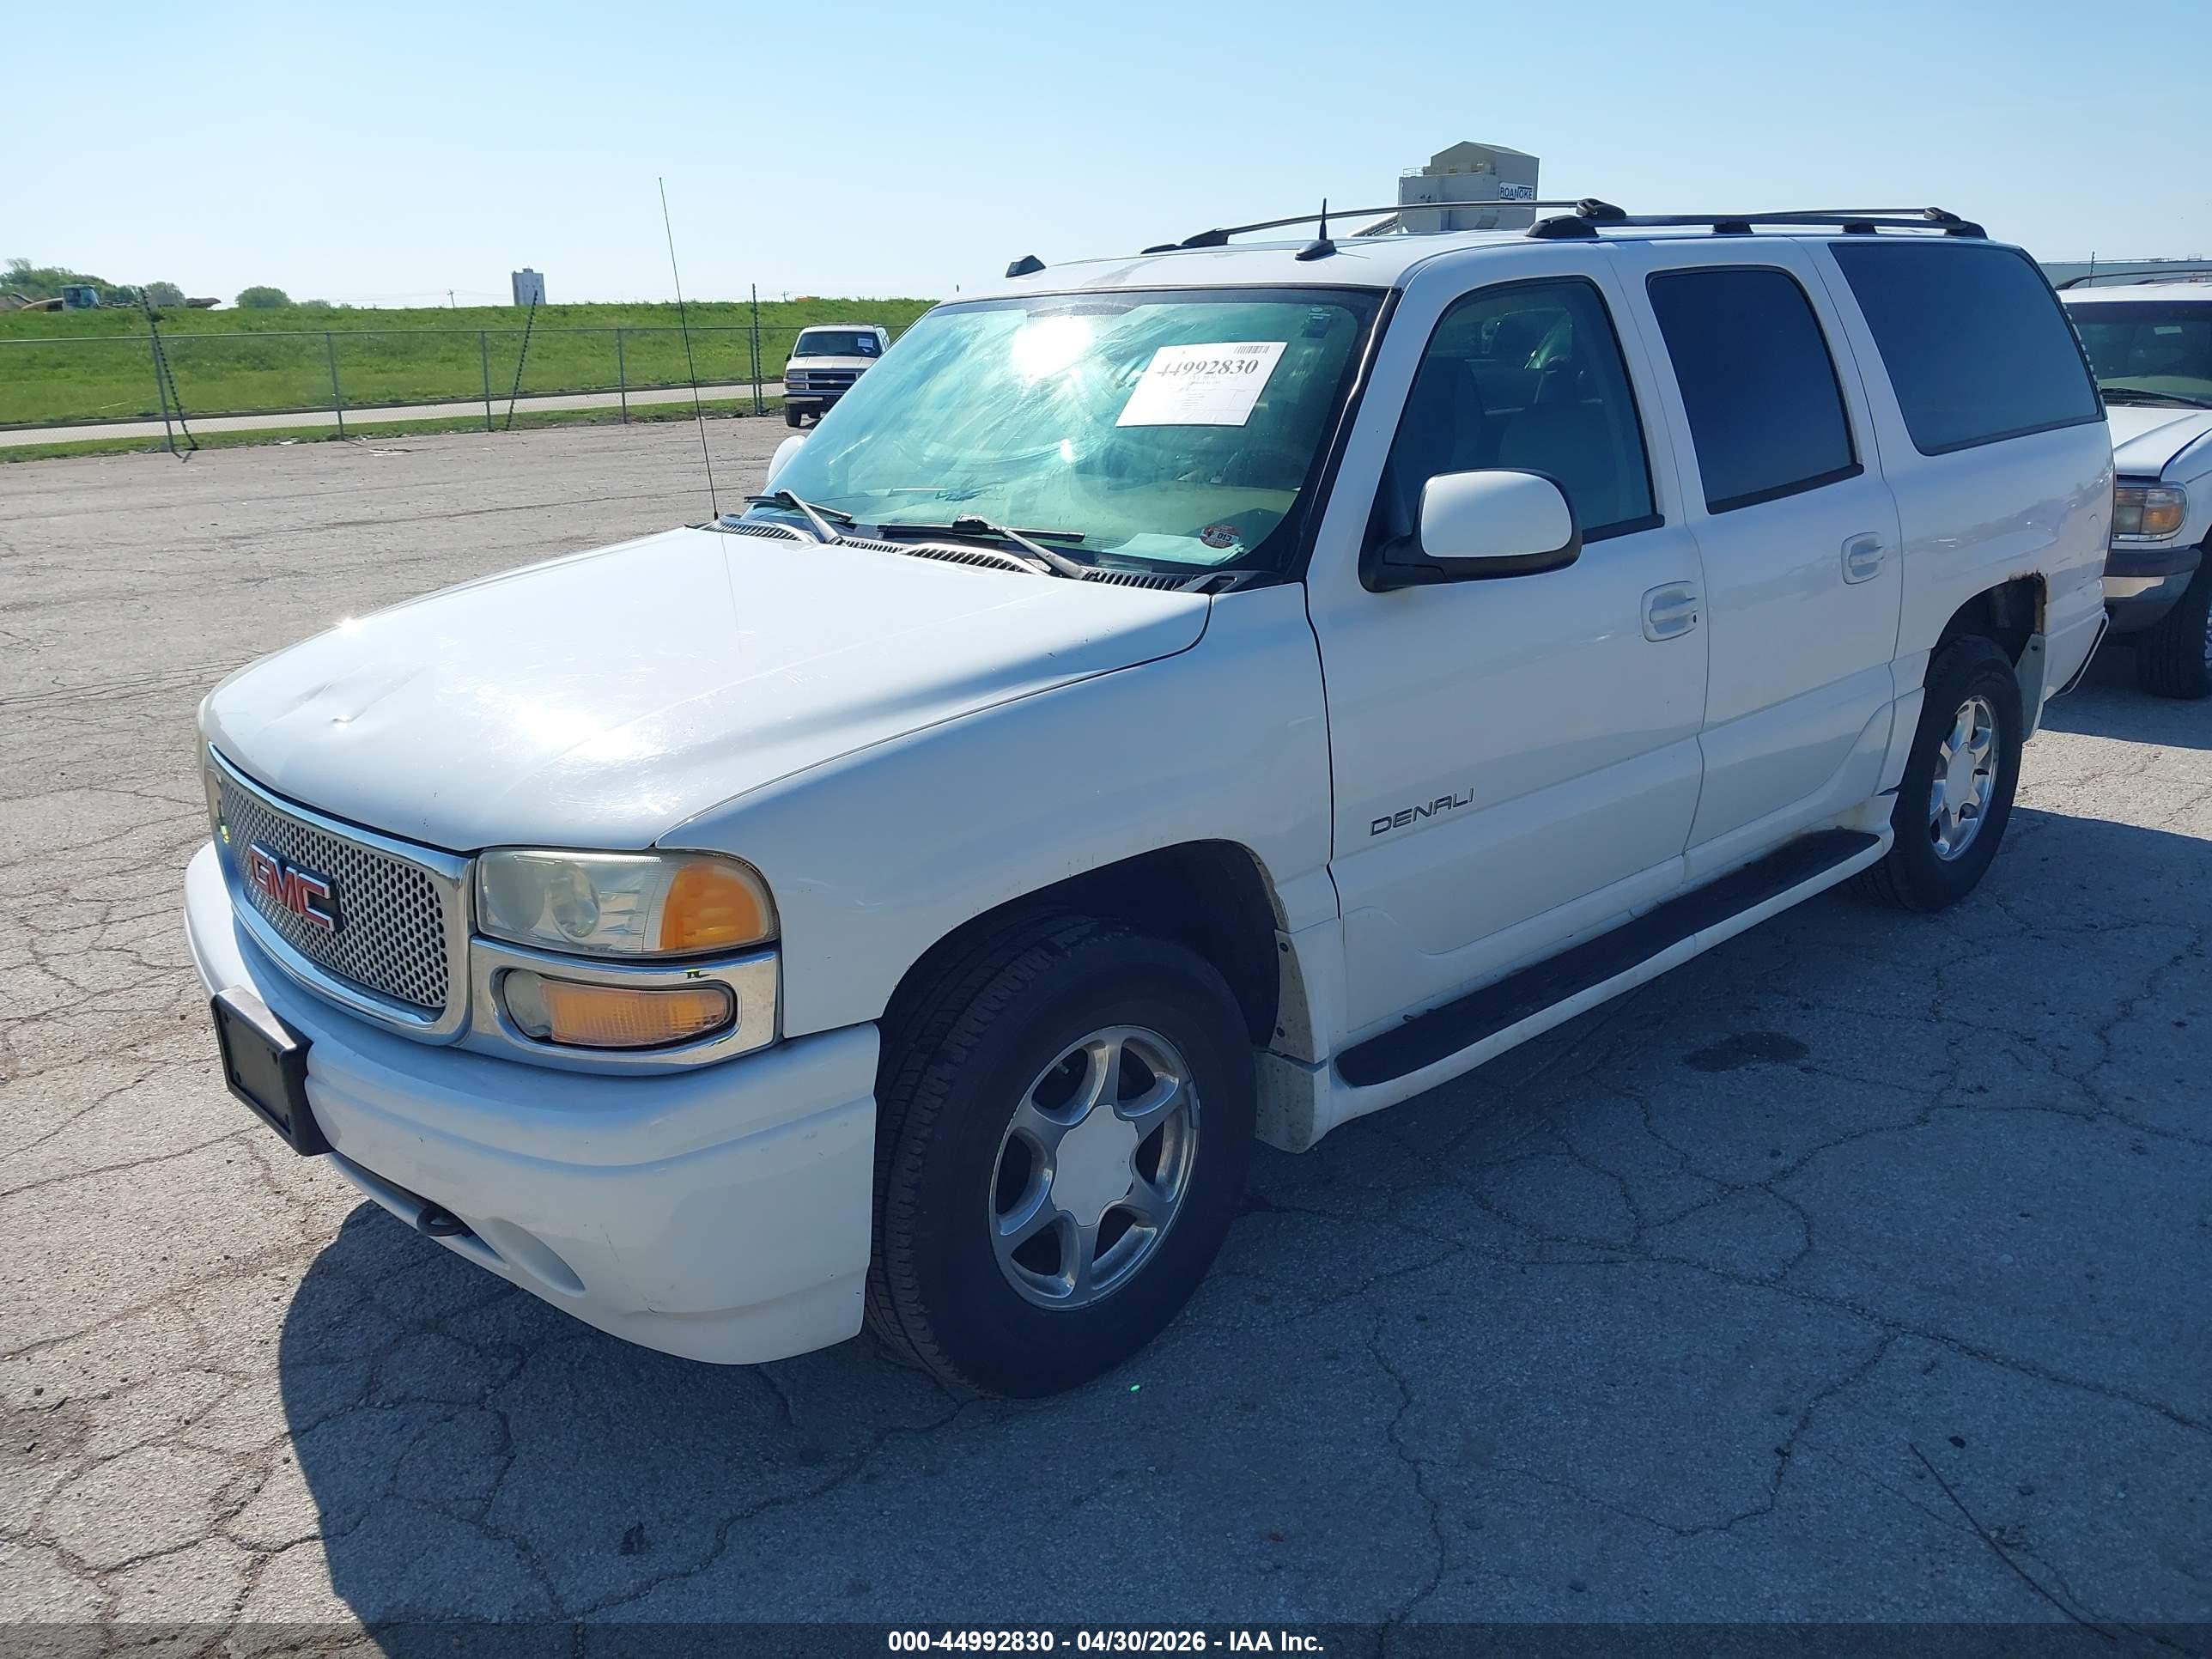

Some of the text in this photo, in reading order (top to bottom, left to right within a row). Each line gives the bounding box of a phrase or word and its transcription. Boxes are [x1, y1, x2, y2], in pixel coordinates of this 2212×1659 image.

[1500, 186, 1533, 200] ROANOKE
[1157, 359, 1259, 376] 44992830
[1370, 787, 1474, 836] DENALI
[248, 843, 335, 932] GMC
